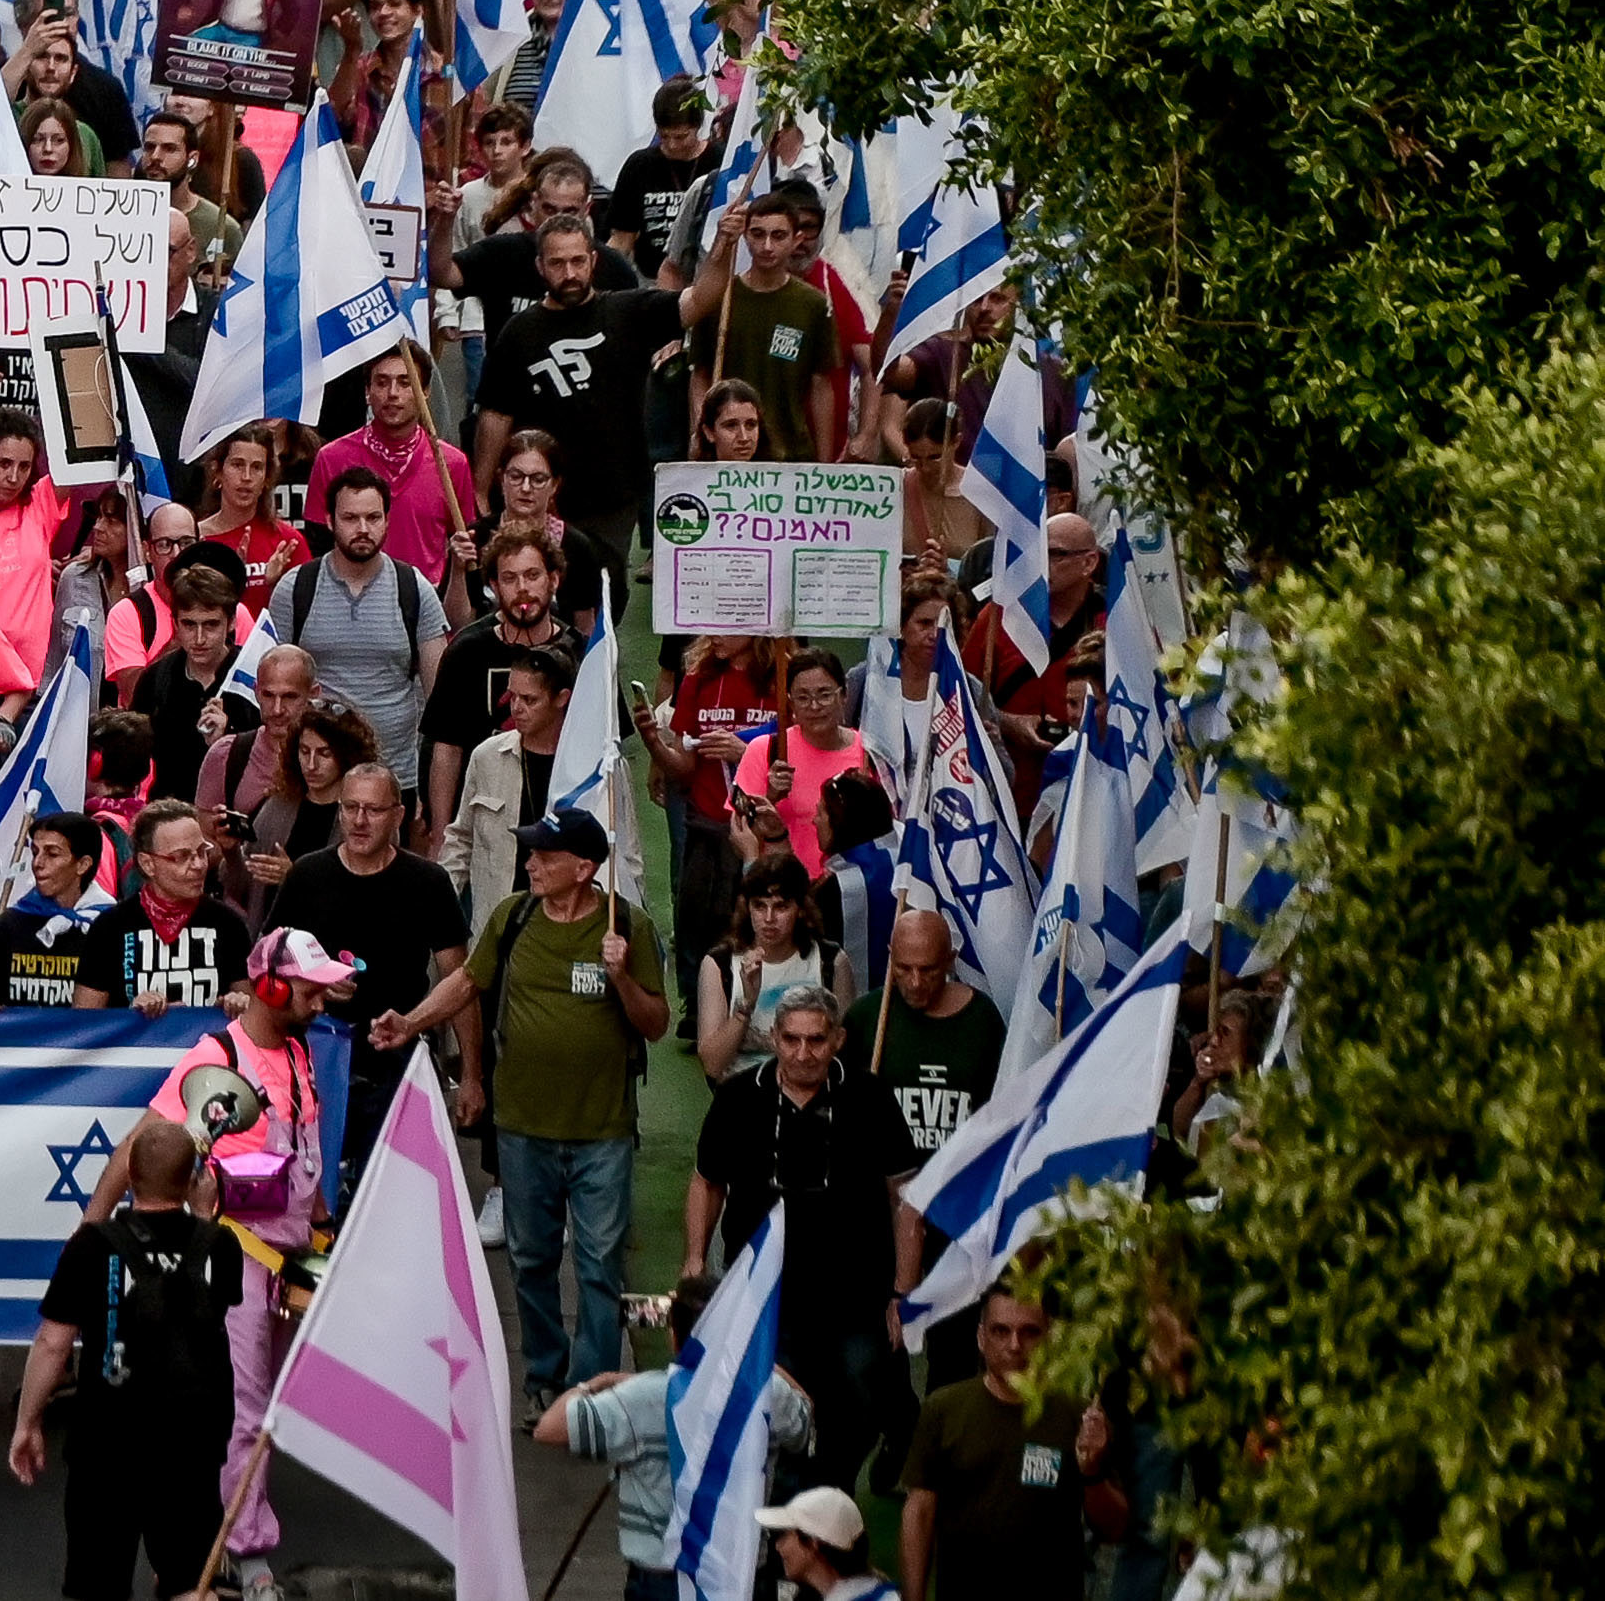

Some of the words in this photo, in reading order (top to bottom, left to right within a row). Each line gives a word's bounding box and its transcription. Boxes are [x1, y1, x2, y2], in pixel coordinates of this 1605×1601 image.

[186, 41, 220, 57] BLAME
[221, 47, 232, 58] IT
[232, 48, 248, 61] ON
[25, 178, 63, 212] של
[76, 180, 164, 216] ירושלים
[95, 224, 153, 264] ושל
[338, 286, 388, 320] חופשי
[346, 301, 395, 338] בארצנו
[707, 470, 783, 491] דואגת
[794, 466, 895, 493] הממשלה
[744, 493, 784, 513] סוג
[795, 495, 894, 519] לאזרחים
[715, 513, 851, 543] האמנם??
[9, 977, 75, 1005] אקדמיה
